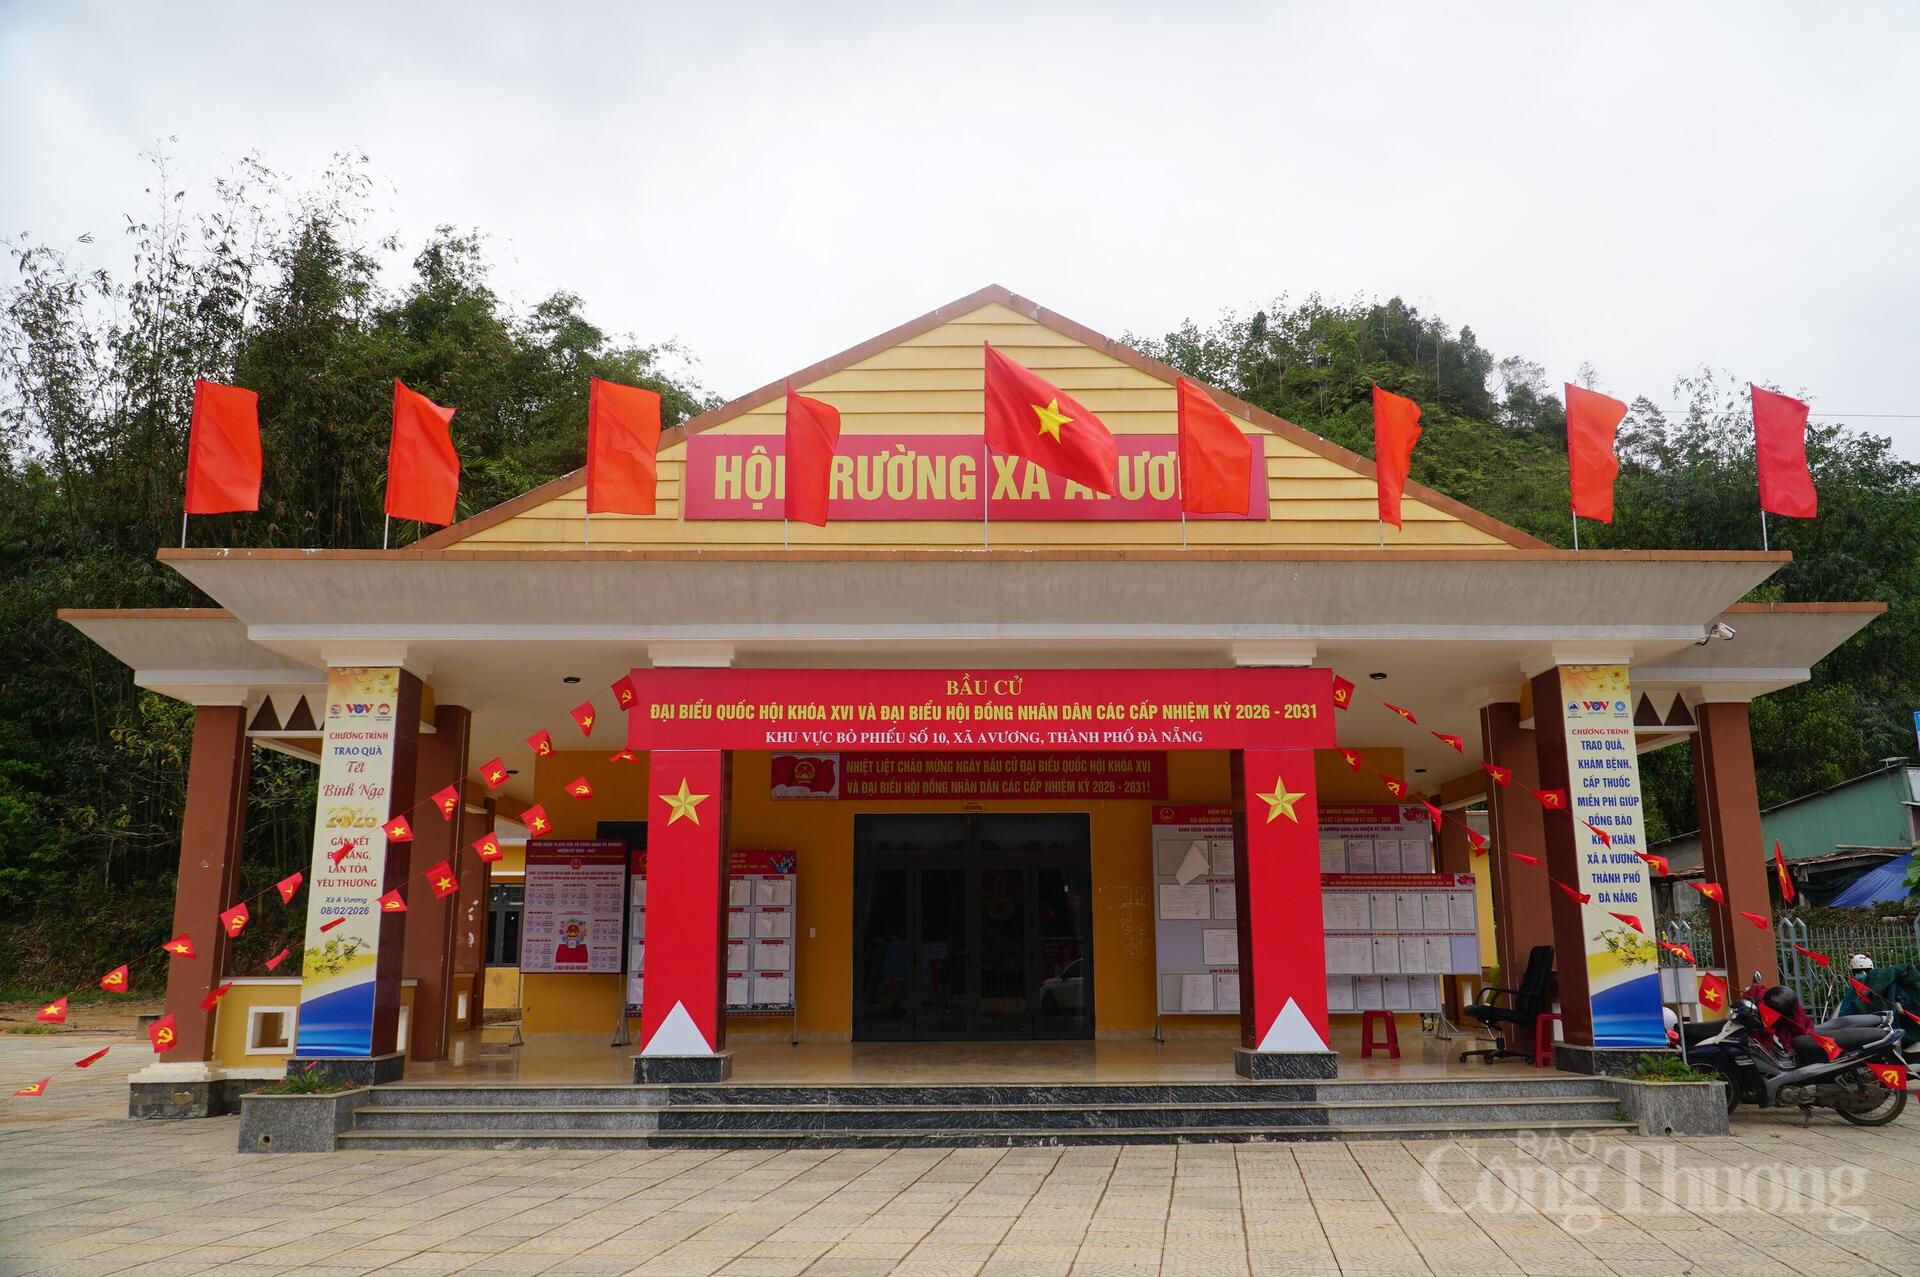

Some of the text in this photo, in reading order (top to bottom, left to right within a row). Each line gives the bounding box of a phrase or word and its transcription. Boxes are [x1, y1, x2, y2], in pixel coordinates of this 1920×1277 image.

[714, 445, 785, 510] HỘI
[829, 444, 977, 500] RƯỜNG
[946, 673, 1023, 696] BẦU CỬ
[346, 703, 374, 714] VOV
[651, 703, 674, 722] ĐẠI
[679, 698, 711, 720] BIỂU
[717, 699, 754, 720] QUỐC
[760, 702, 783, 722] HỘI
[788, 702, 826, 720] KHÓA
[831, 705, 853, 720] XVI
[858, 702, 876, 720] VÀ
[881, 705, 904, 722] ĐẠI
[909, 699, 941, 720] BIỂU
[946, 702, 969, 722] HỘI
[974, 700, 1013, 720] ĐỒNG
[1018, 702, 1058, 720] NHÂN
[1063, 702, 1092, 720] DÂN
[1097, 701, 1125, 720] CÁC
[1130, 699, 1158, 720] CẤP
[1163, 702, 1209, 723] NHIỆM
[1214, 701, 1231, 720] KỲ
[1236, 704, 1270, 720] 2026
[1285, 704, 1317, 719] 2031
[1582, 700, 1609, 711] VOV
[329, 730, 389, 740] CHƯƠNG TRÌNH
[766, 732, 797, 743] KHU
[803, 731, 832, 746] VỰC
[837, 728, 856, 743] BỎ
[861, 728, 905, 744] PHIẾU
[909, 728, 928, 744] SỐ
[933, 733, 950, 745] 10,
[954, 730, 972, 743] XÃ
[1048, 729, 1099, 743] THÀNH
[1104, 727, 1134, 743] PHỐ
[1138, 729, 1157, 743] ĐÀ
[1162, 727, 1203, 743] NẴNG
[334, 746, 360, 756] TRAO
[1580, 740, 1603, 750] TRAO
[847, 760, 873, 775] NHIỆT
[876, 760, 894, 775] LIỆT
[898, 758, 923, 773] CHÀO
[957, 758, 980, 773] NGÀY
[1021, 760, 1036, 775] ĐẠI
[1063, 757, 1087, 773] QUỐC
[1091, 759, 1105, 774] HỘI
[1136, 761, 1151, 772] XVI
[904, 780, 919, 796] HỘI
[952, 779, 976, 793] NHÂN
[1002, 780, 1021, 793] CÁC
[1045, 780, 1075, 795] NHIỆM
[1093, 781, 1115, 793] 2026
[1583, 774, 1631, 788] CẤP THUỐC
[325, 806, 378, 828] 2026
[337, 878, 377, 887] THƯƠNG
[1592, 870, 1640, 883] THÀNH PHỐ
[320, 906, 370, 915] 08/02/2026
